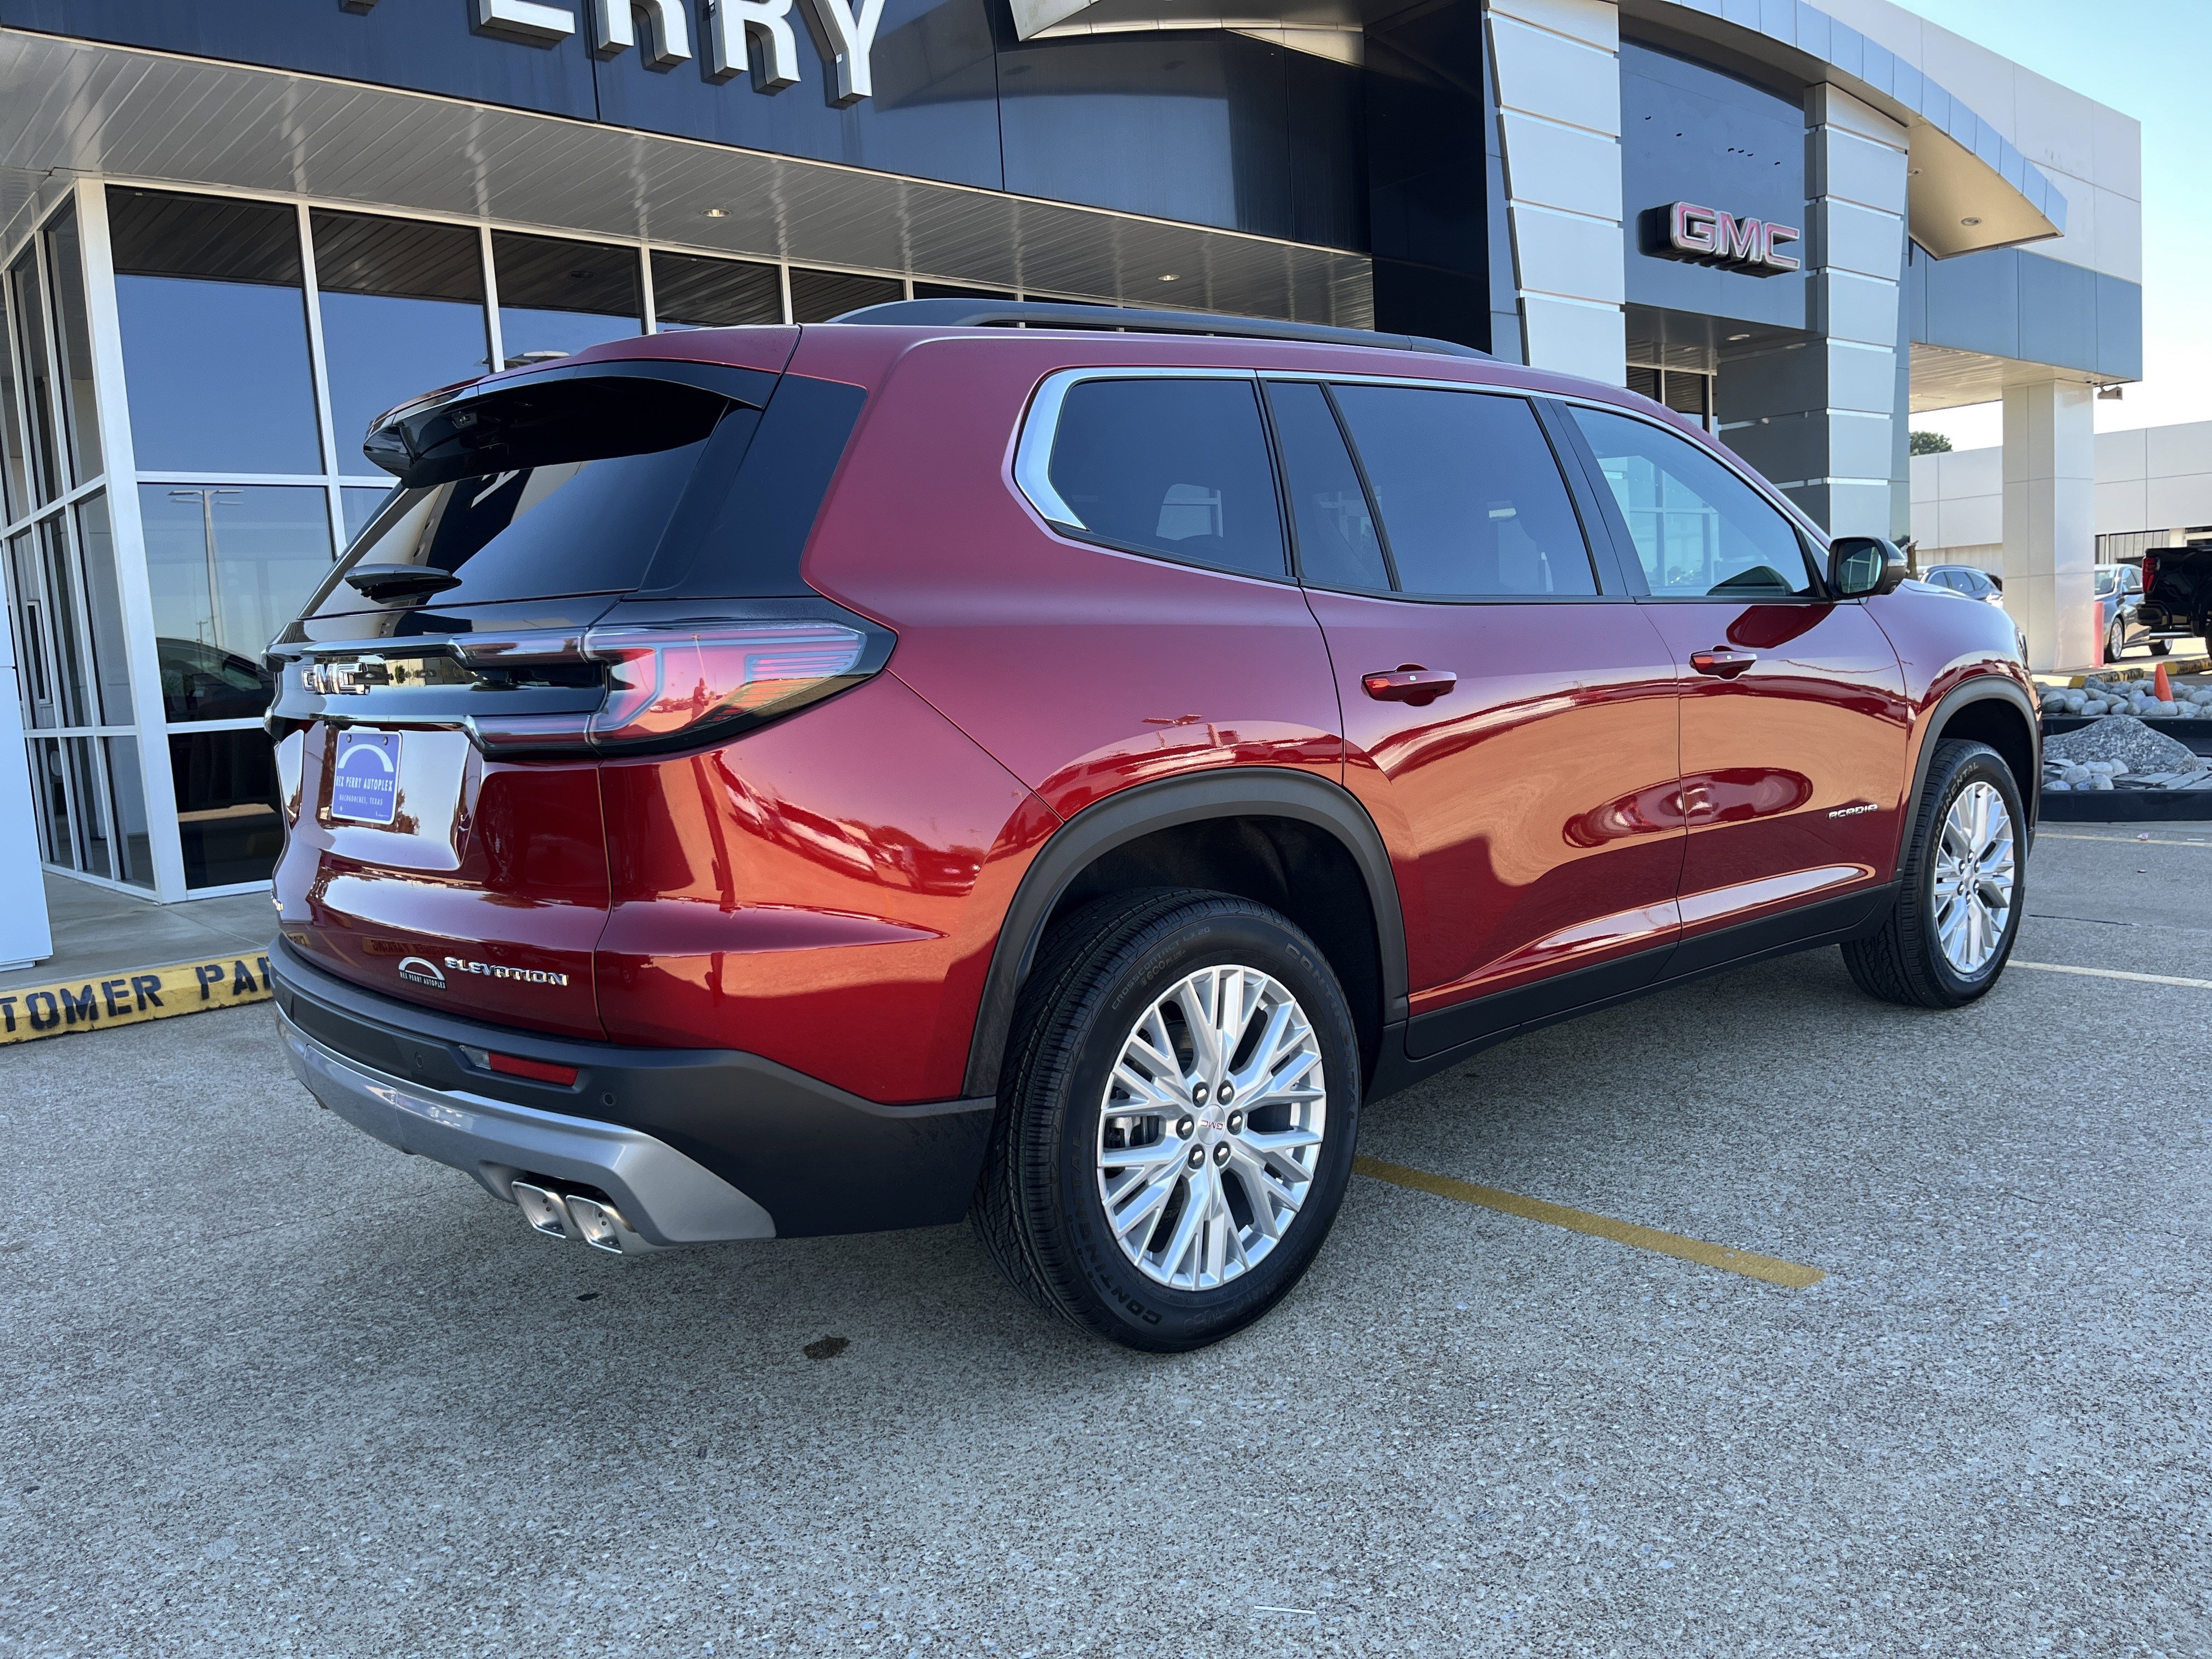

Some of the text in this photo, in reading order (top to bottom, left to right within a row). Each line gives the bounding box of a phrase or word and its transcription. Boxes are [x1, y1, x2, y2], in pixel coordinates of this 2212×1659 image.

[1670, 201, 1801, 272] GMC
[302, 663, 370, 695] GMC
[336, 775, 393, 792] REX PERRY AUTOPLEX
[369, 798, 383, 806] TEXAS
[1827, 804, 1878, 819] ACADIA
[409, 973, 422, 984] PERRY
[423, 977, 446, 989] AUTOPLEX
[444, 956, 569, 986] ELEVATION
[1111, 939, 1180, 1010] CROSSCONTACT
[1200, 1120, 1223, 1130] GMC
[1071, 1126, 1163, 1326] CONTINENTAL
